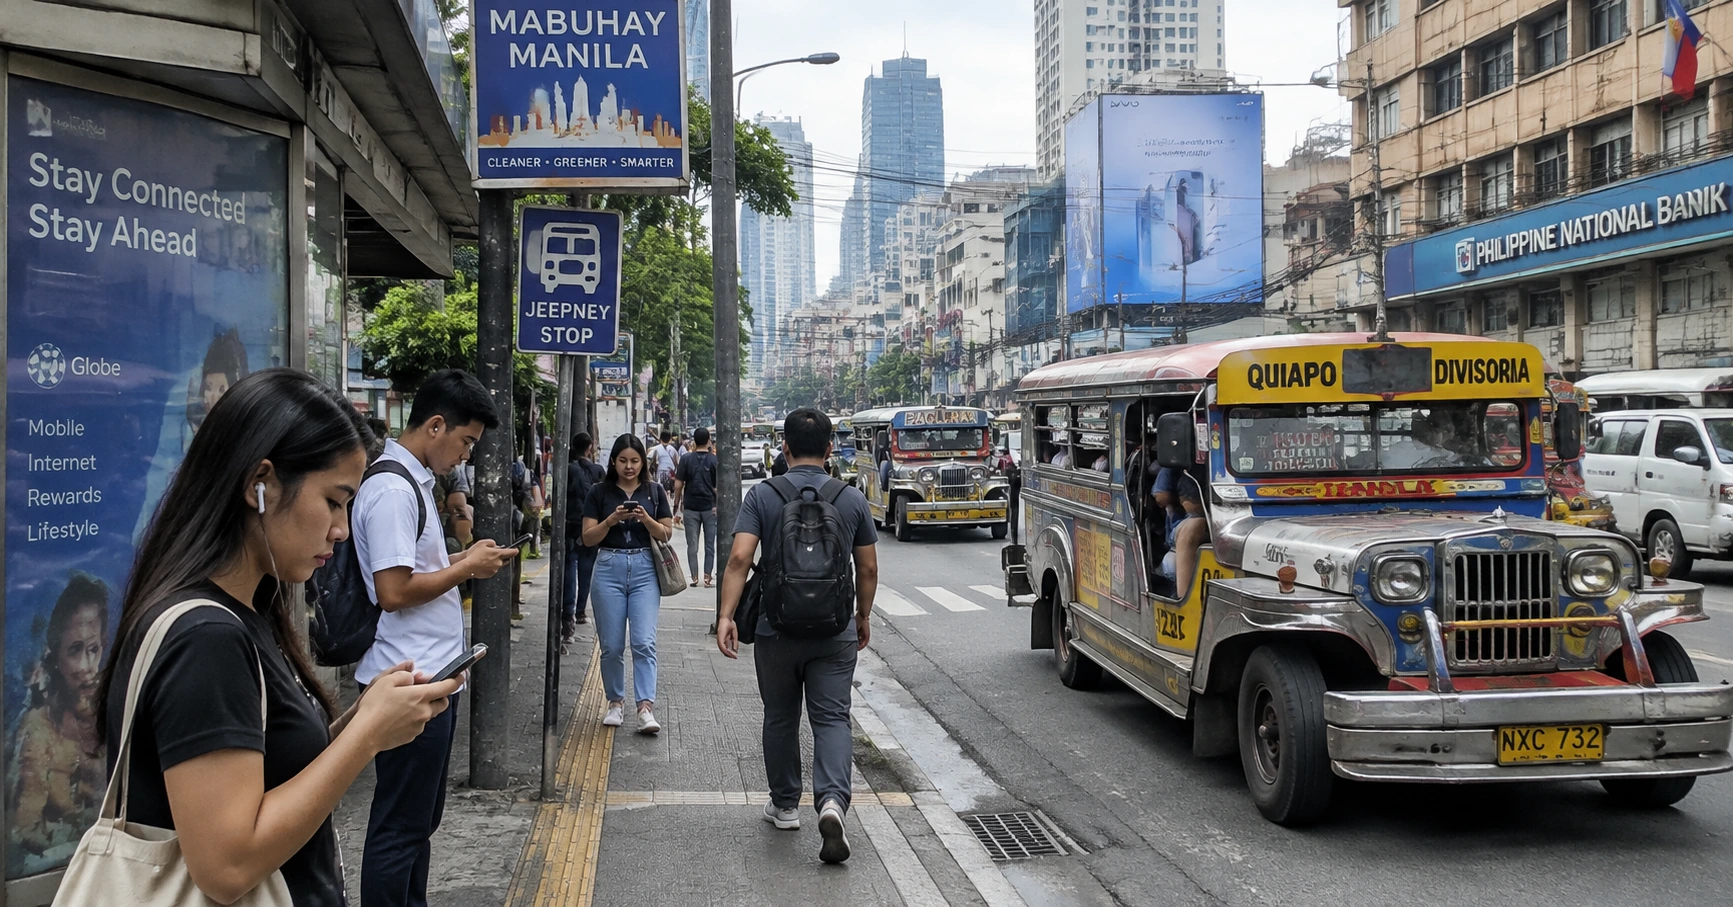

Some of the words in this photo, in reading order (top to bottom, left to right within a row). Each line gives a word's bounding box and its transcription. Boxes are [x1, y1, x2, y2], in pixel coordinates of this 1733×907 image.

[489, 9, 666, 36] MABUHAY
[509, 42, 649, 69] MANILA
[487, 157, 541, 168] CLEANER
[620, 157, 674, 168] SMARTER
[28, 152, 103, 205] Stay
[111, 167, 246, 225] Connected
[28, 203, 103, 253] Stay
[110, 215, 197, 257] Ahead
[1476, 224, 1557, 266] PHILIPPINE
[1560, 201, 1653, 247] NATIONAL
[525, 301, 611, 320] JEEPNEY
[540, 326, 594, 345] STOP
[71, 356, 121, 376] Globe
[1247, 361, 1337, 391] QUIAPO
[28, 418, 85, 437] Mobile
[28, 454, 97, 472] Internet
[28, 486, 102, 507] Rewards
[28, 519, 99, 542] Lifestyle
[1501, 728, 1546, 752] NXC
[1556, 726, 1600, 750] 732
